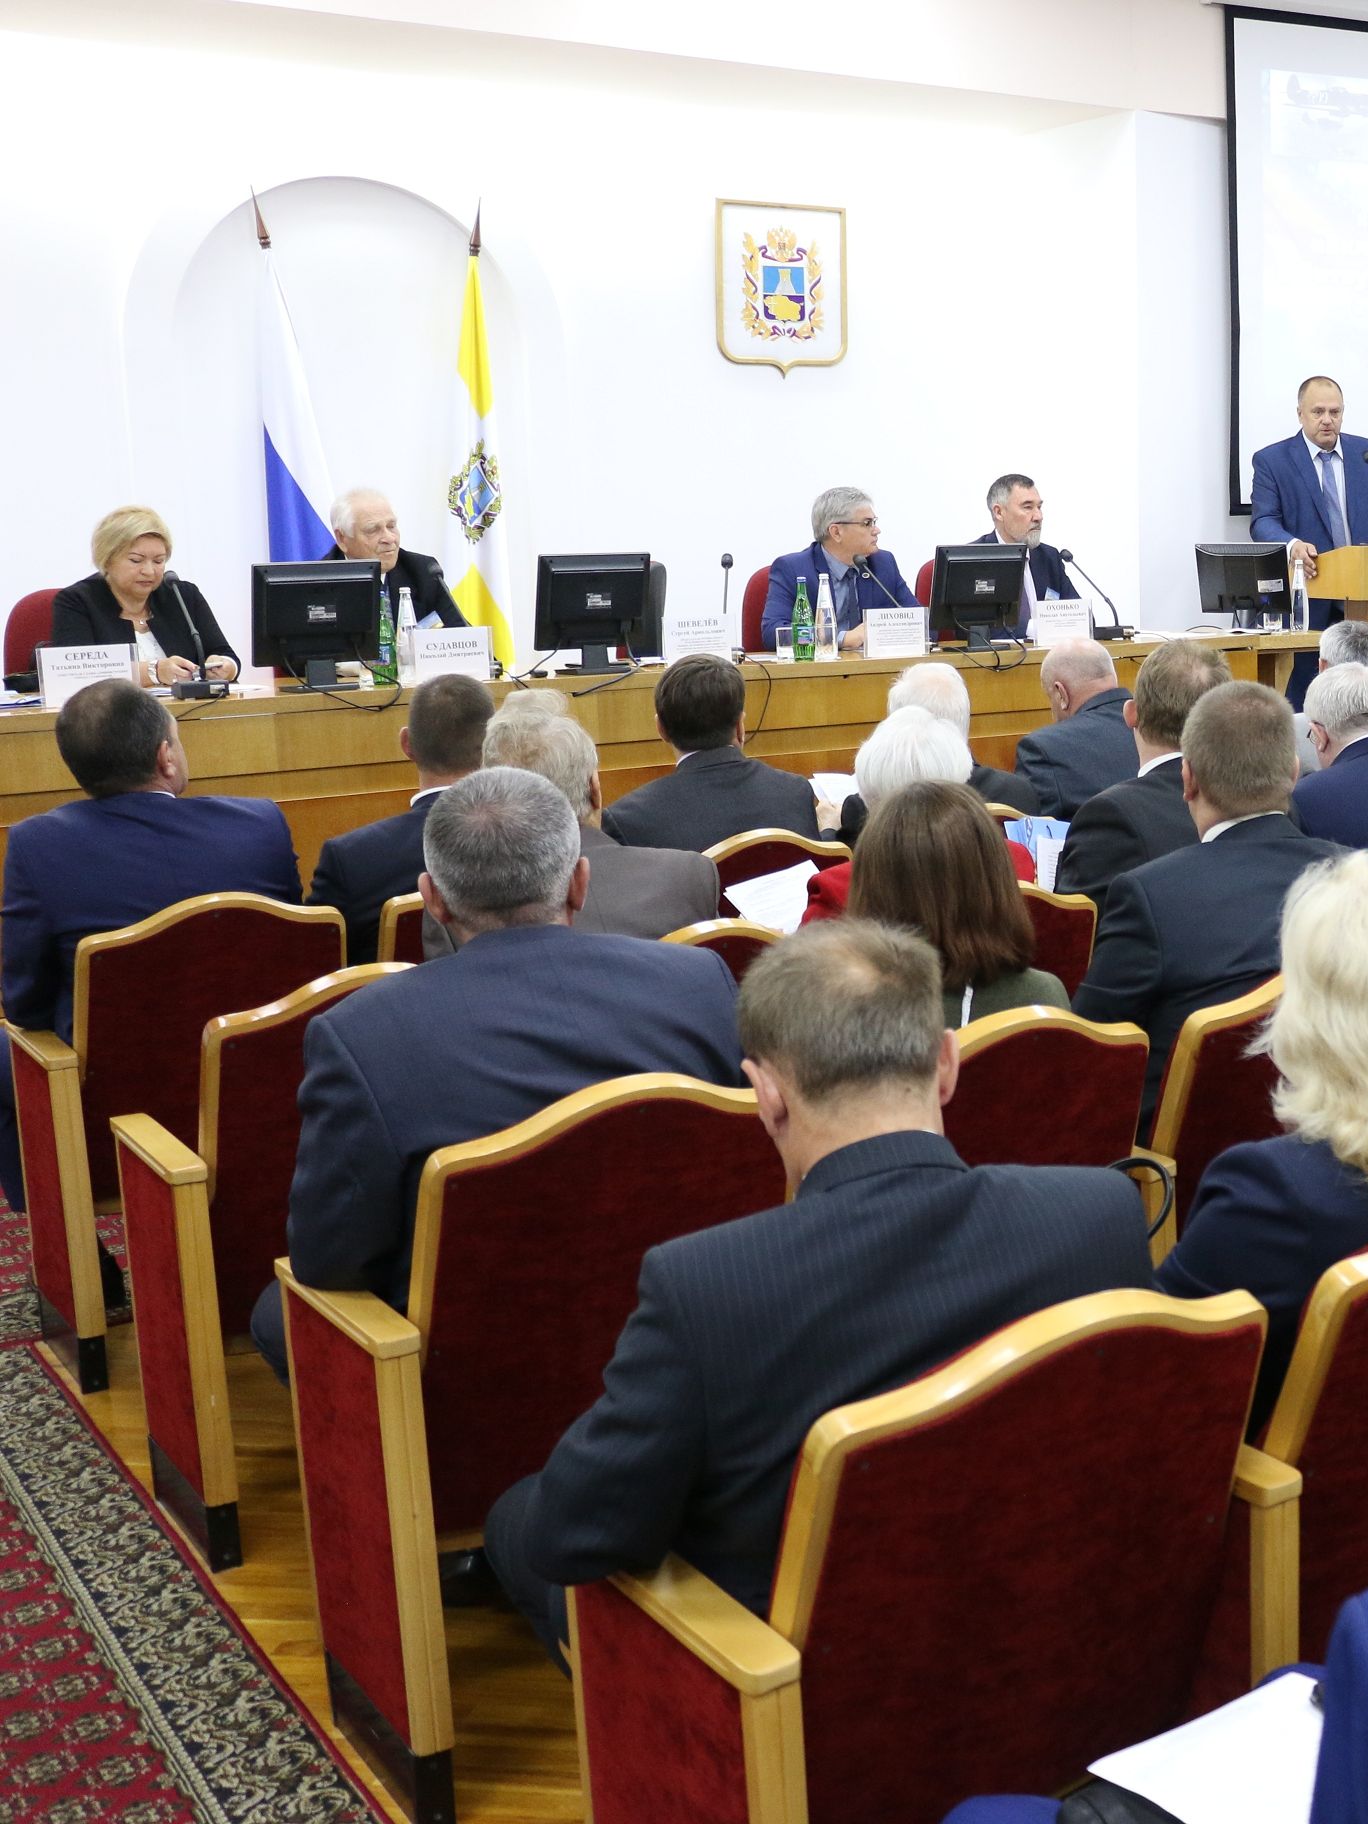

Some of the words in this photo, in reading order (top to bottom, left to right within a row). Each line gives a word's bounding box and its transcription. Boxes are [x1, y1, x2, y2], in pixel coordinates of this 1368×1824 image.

[878, 612, 914, 620] ЛИХОВИД
[426, 640, 478, 651] СУДАВЦОВ
[65, 651, 109, 661] СЕРЕДА
[83, 662, 125, 670] Викторовна
